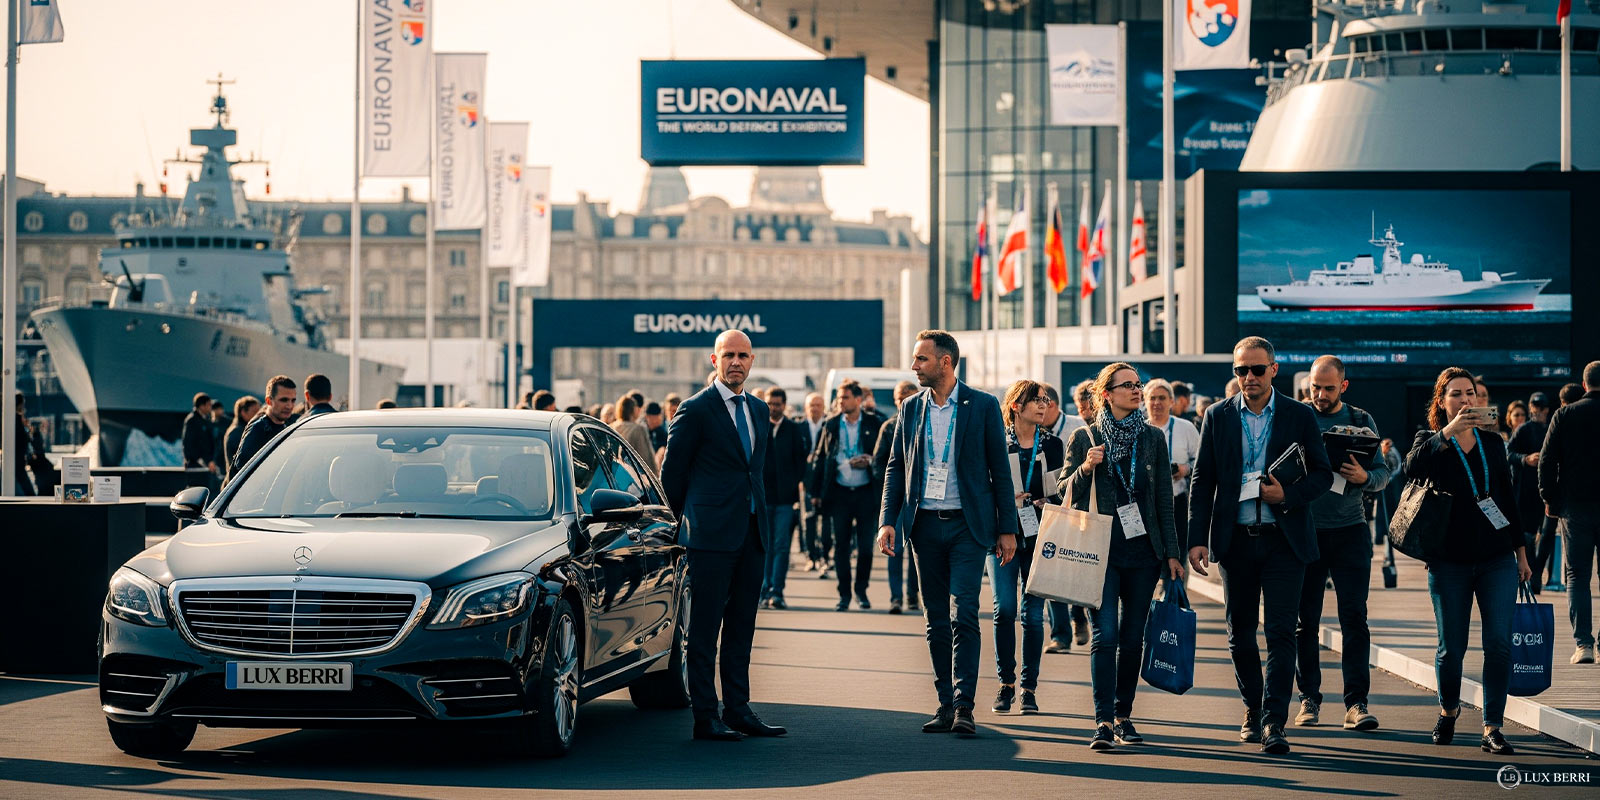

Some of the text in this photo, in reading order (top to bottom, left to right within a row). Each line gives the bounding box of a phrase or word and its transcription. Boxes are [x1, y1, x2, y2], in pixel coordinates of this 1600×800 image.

[656, 87, 847, 113] EURONAVAL
[656, 121, 681, 133] THE
[682, 121, 728, 133] WORLD
[633, 313, 767, 333] EURONAVAL
[243, 667, 344, 685] LUX BERRI
